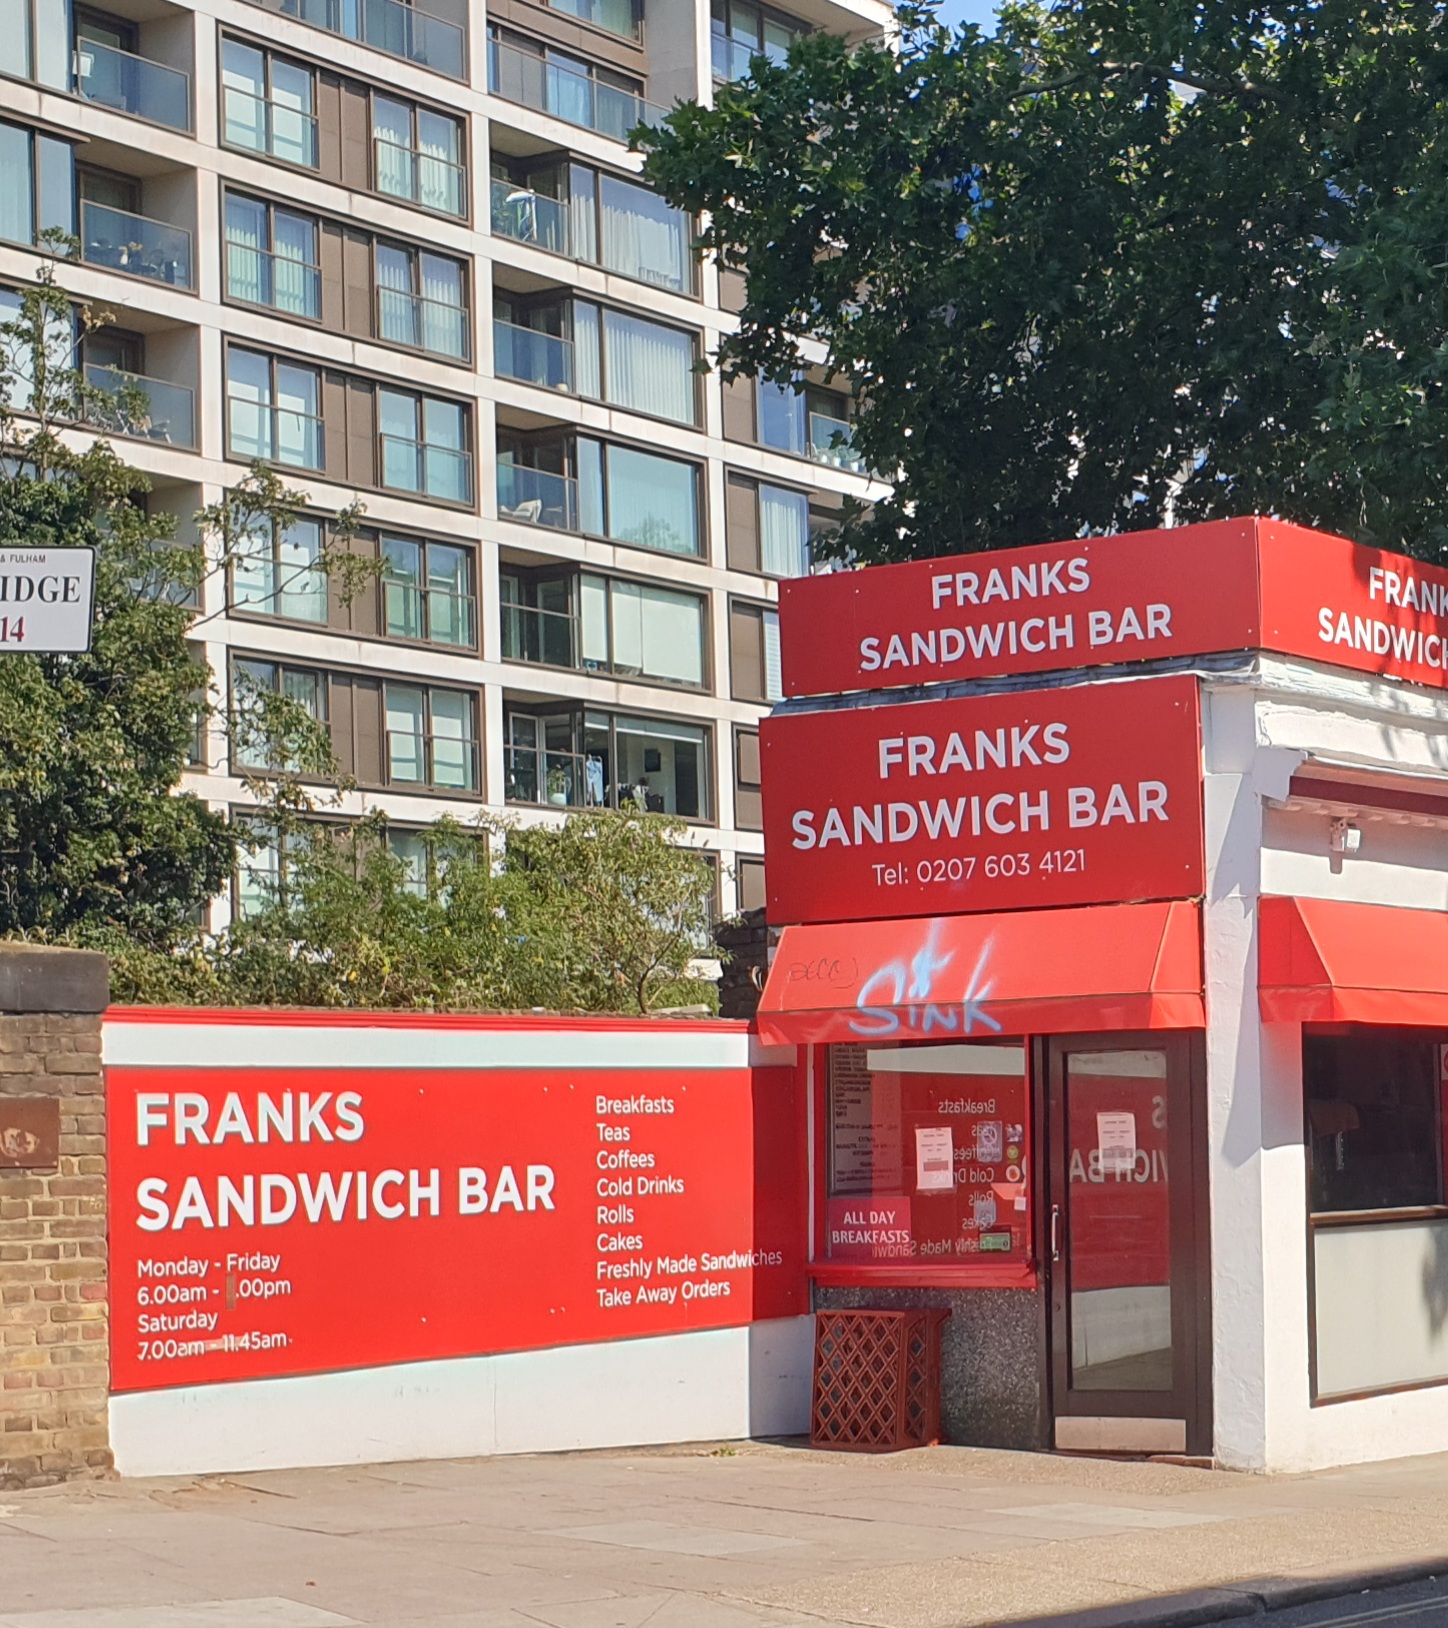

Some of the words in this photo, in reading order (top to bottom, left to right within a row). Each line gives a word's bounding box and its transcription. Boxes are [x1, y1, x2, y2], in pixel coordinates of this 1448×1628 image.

[9, 554, 46, 563] FULHAM
[931, 557, 1090, 610] FRANKS
[860, 614, 1074, 671] SANDWICH
[1088, 603, 1173, 646] BAR
[878, 722, 1070, 779] FRANKS
[791, 790, 1049, 850] SANDWICH
[1067, 780, 1169, 829] BAR
[872, 862, 909, 886] Tel:
[916, 857, 976, 883] 0207
[984, 853, 1030, 879] 603
[1039, 849, 1086, 873] 4121
[596, 1094, 675, 1114] Breakfasts
[136, 1092, 365, 1146] FRANKS
[596, 1123, 631, 1141] Teas
[596, 1149, 655, 1169] Coffees
[135, 1168, 440, 1232] SANDWICH
[458, 1164, 555, 1215] BAR
[597, 1176, 633, 1197] Cold
[637, 1175, 684, 1195] Drinks
[596, 1204, 635, 1224] Rolls
[843, 1211, 866, 1225] ALL
[869, 1210, 896, 1224] DAY
[596, 1232, 643, 1252] Cakes
[832, 1229, 910, 1244] BREAKFASTS
[137, 1256, 209, 1278] Monday
[226, 1251, 281, 1272] Friday
[596, 1258, 652, 1280] Freshly
[656, 1254, 698, 1275] Made
[701, 1248, 783, 1271] Sandwiches
[137, 1284, 207, 1306] 6.00am
[226, 1278, 291, 1299] .00pm
[596, 1287, 632, 1308] Take
[635, 1285, 677, 1304] Away
[681, 1279, 731, 1300] Orders
[138, 1309, 218, 1334] Saturday
[137, 1339, 205, 1361] 7.00am
[222, 1331, 287, 1352] 11.45am
